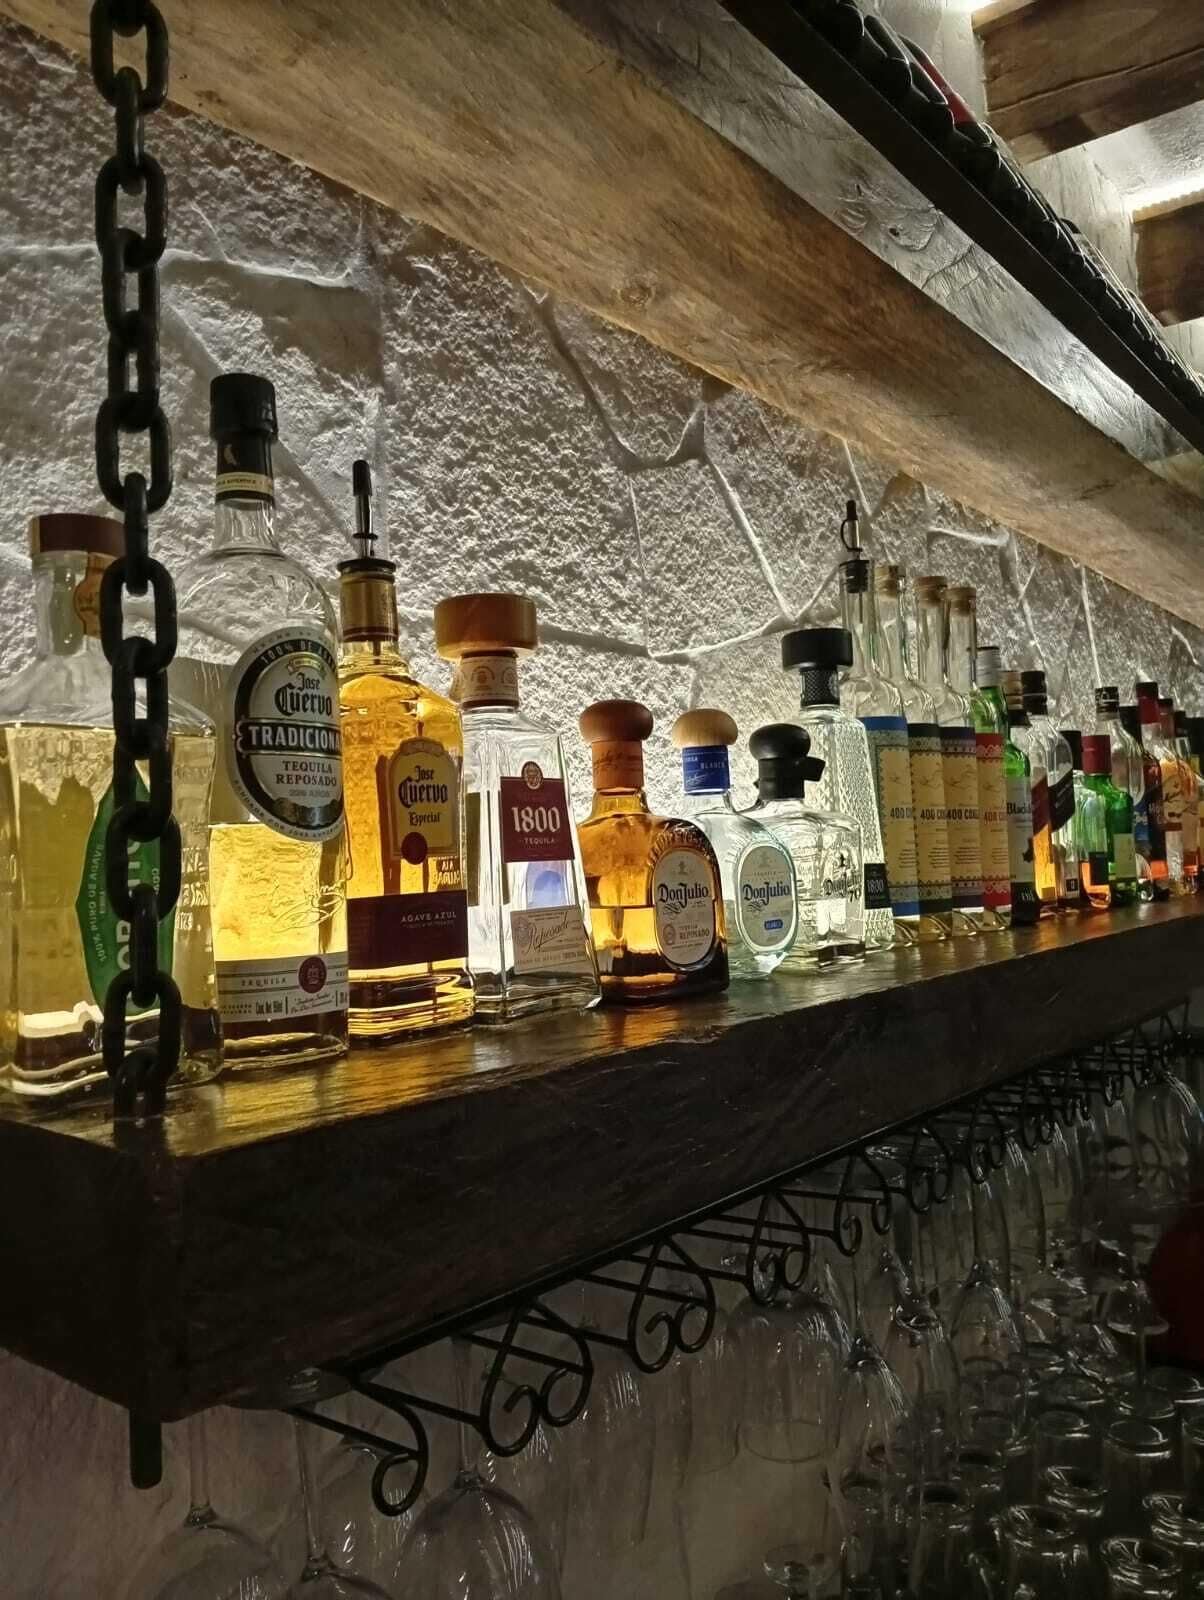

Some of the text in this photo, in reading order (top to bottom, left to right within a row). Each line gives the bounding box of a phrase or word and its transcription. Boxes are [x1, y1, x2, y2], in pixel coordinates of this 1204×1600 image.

[298, 672, 320, 691] Jose
[275, 682, 333, 717] Cuervo
[248, 726, 341, 751] TRADICIONA
[282, 760, 333, 774] TEQUILA
[414, 765, 435, 783] Jose
[276, 773, 337, 788] REPOSADO
[399, 775, 449, 809] Cuervo
[408, 811, 441, 827] Especial
[511, 806, 561, 832] 1800
[946, 809, 962, 821] 400
[524, 837, 555, 845] TEQUILA
[88, 883, 97, 898] DE
[88, 901, 99, 932] PURO
[401, 911, 457, 923] AGAVE AZUL
